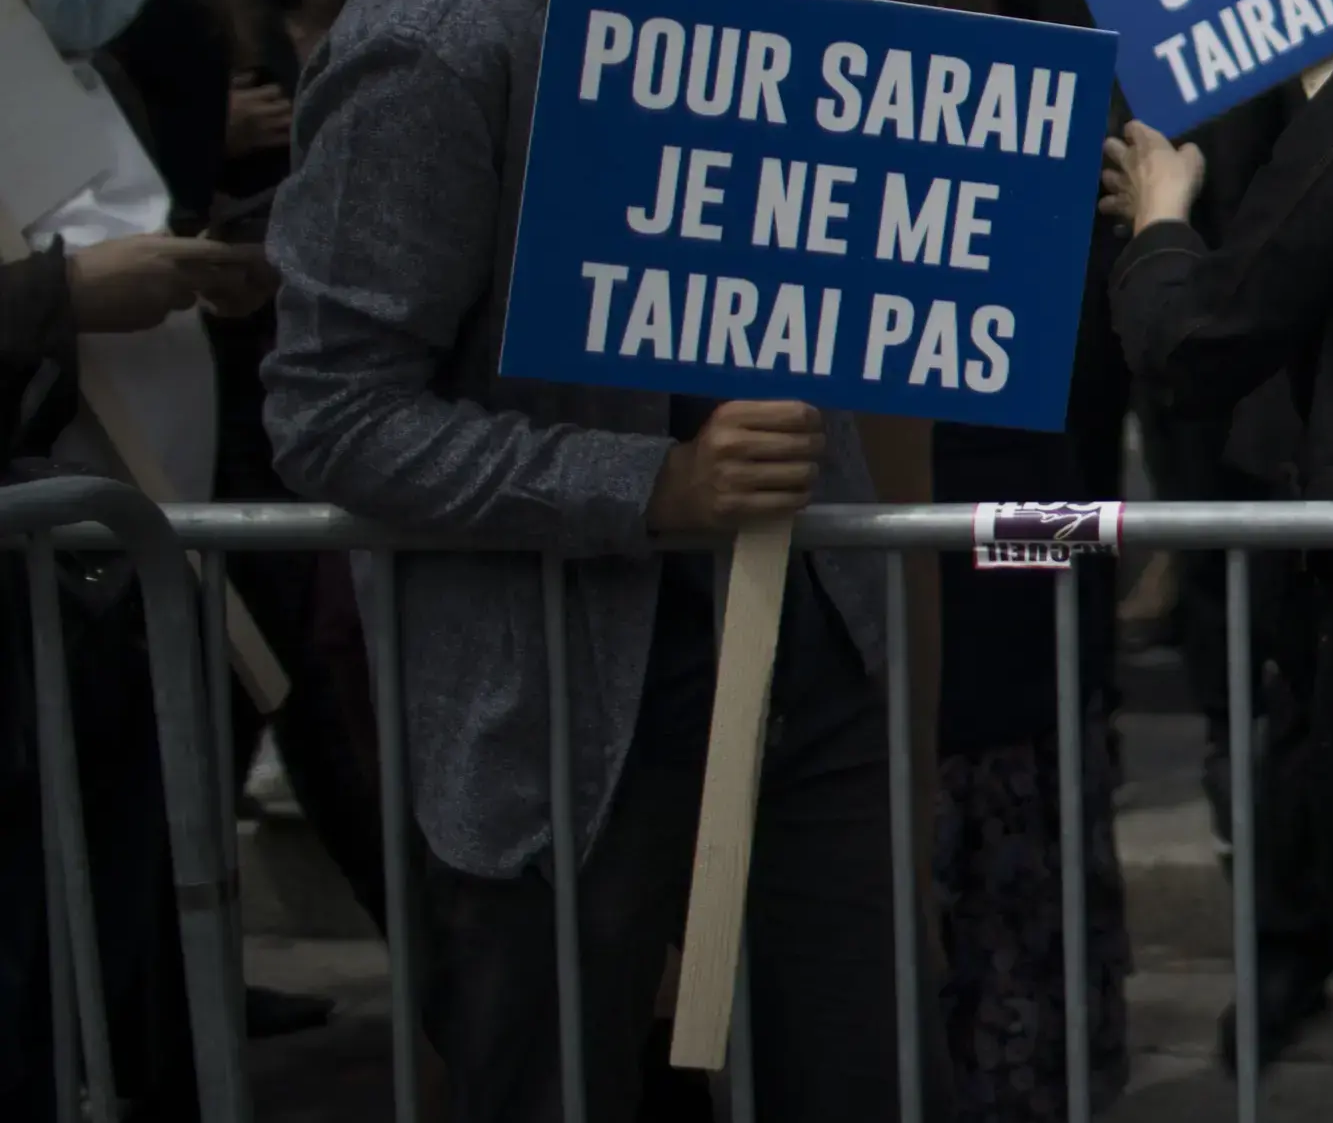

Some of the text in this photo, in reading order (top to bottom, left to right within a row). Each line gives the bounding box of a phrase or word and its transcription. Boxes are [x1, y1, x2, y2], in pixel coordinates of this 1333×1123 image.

[578, 9, 1078, 159] POUR SARAH
[626, 145, 1000, 271] JE NE ME
[582, 261, 1016, 394] TAIRAI PAS
